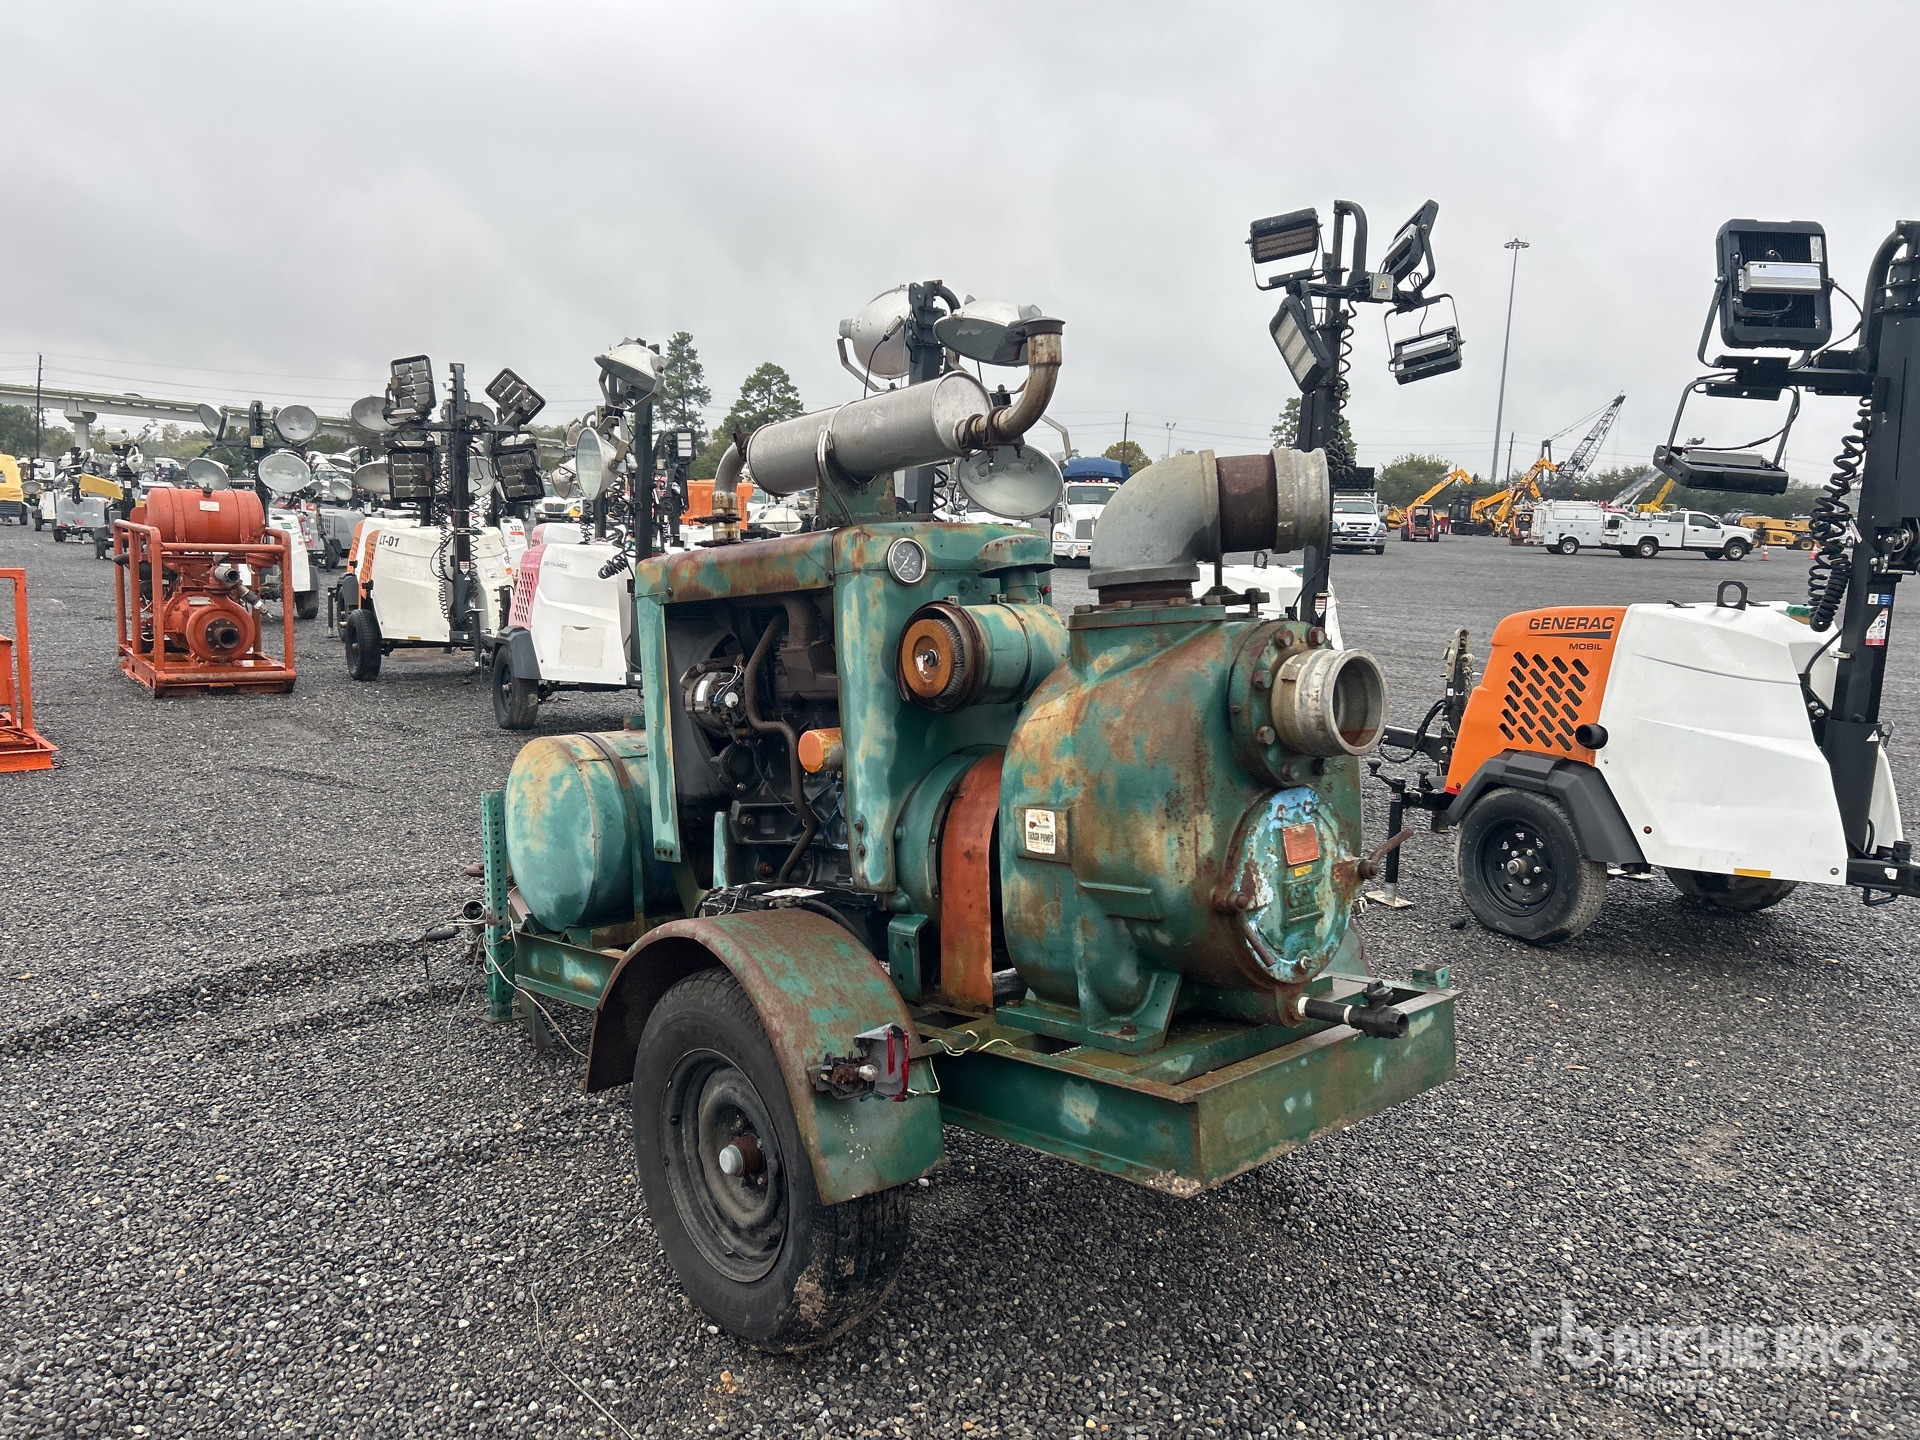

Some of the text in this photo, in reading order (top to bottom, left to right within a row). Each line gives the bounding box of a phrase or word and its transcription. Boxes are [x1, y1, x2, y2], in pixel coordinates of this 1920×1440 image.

[379, 535, 400, 548] LT-01
[1529, 616, 1615, 631] GENERAC
[1040, 833, 1054, 843] PUMPS
